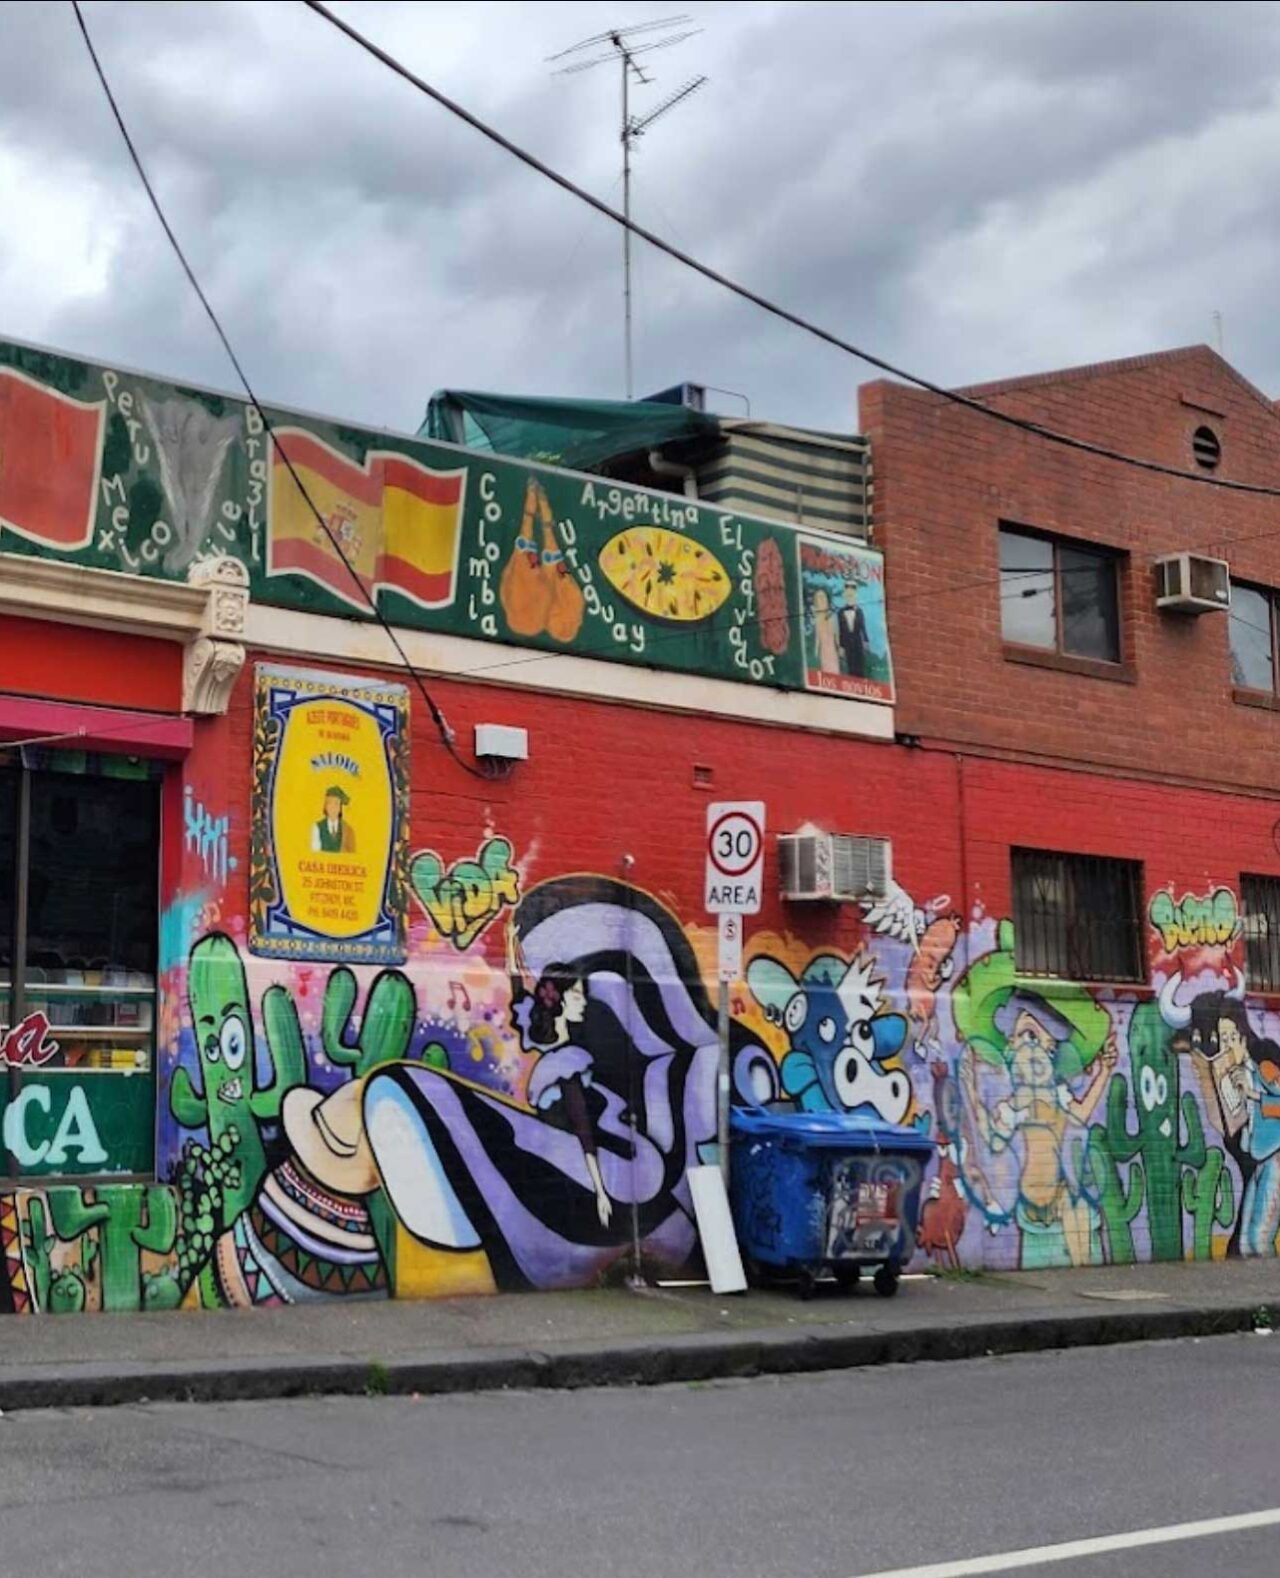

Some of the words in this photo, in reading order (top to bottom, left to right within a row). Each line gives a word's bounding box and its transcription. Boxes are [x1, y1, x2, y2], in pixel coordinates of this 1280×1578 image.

[101, 370, 151, 465] Peru
[97, 473, 172, 568] Mexico
[581, 481, 699, 530] Argentina
[719, 514, 743, 550] El
[468, 472, 502, 636] Colombia
[559, 518, 646, 652] Uruguay
[728, 549, 776, 680] Salvador
[718, 830, 753, 858] 30
[708, 885, 758, 905] AREA
